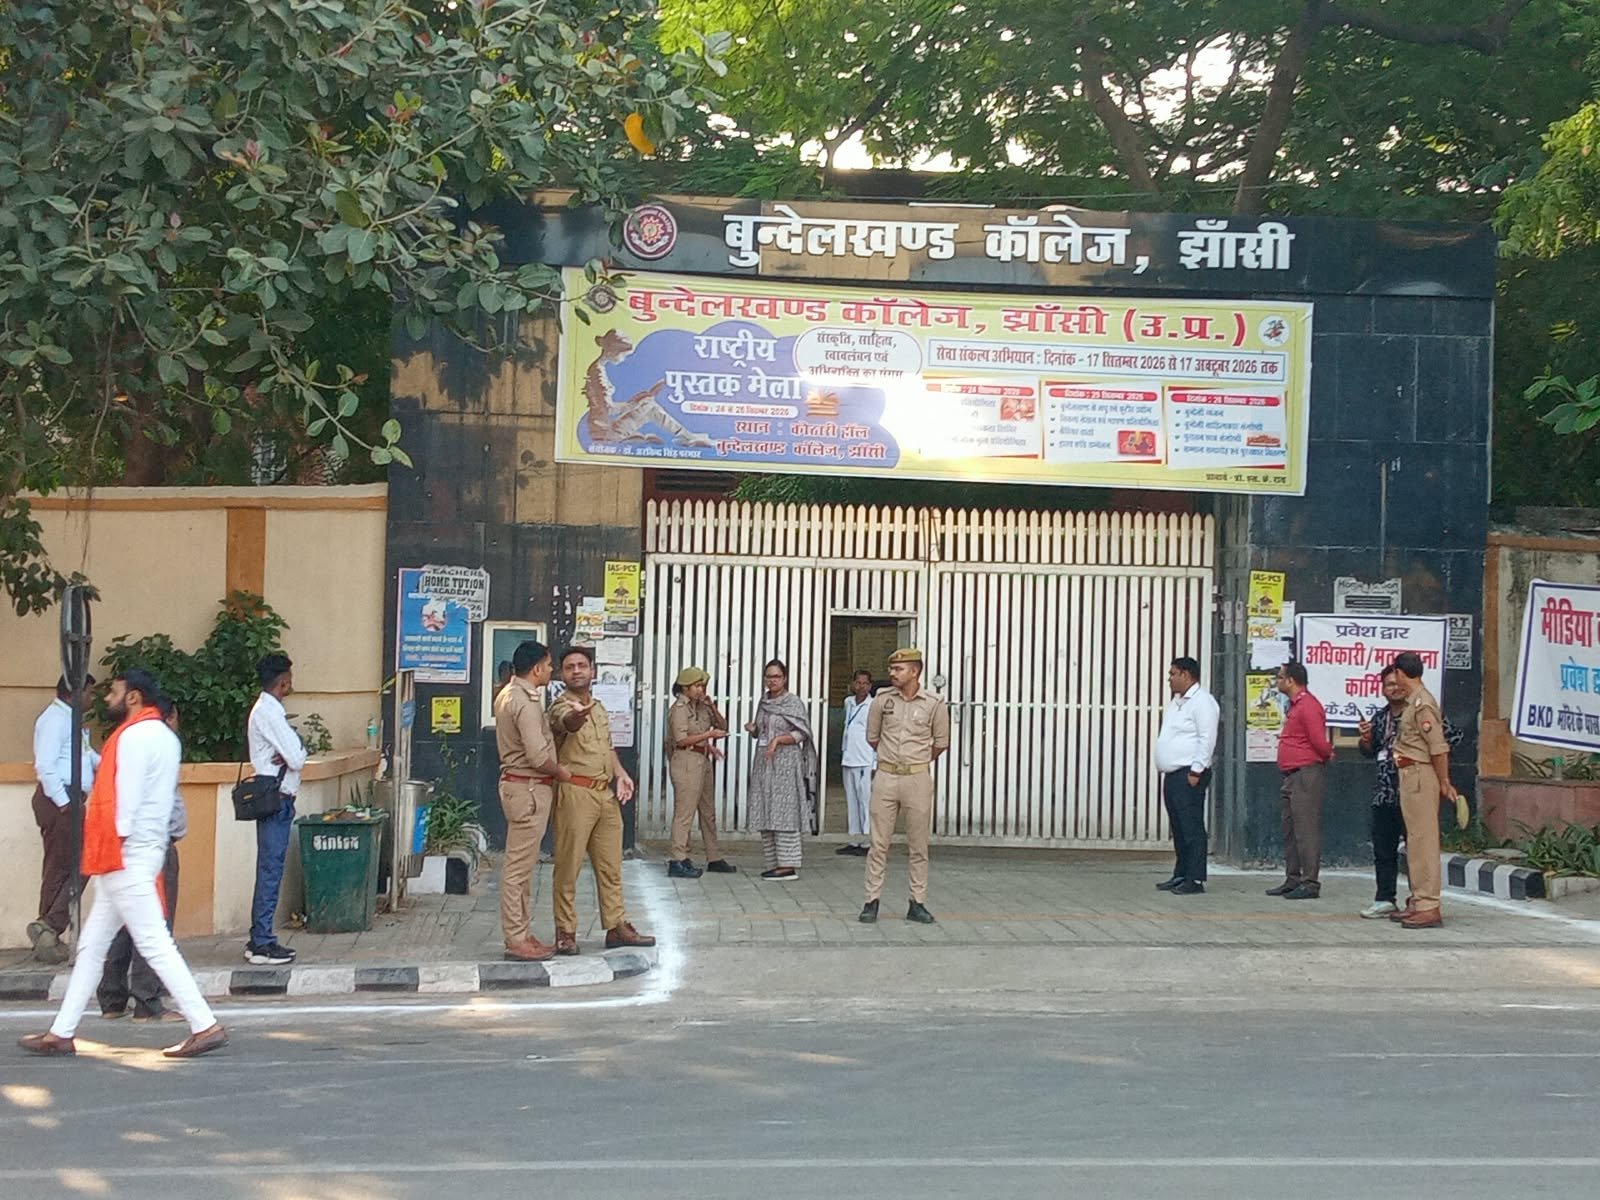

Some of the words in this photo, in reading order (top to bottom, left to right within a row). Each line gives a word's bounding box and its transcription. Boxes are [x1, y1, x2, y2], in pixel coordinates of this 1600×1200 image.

[723, 204, 958, 267] बुन्देलखण्ड
[984, 214, 1149, 273] कॉलेज,
[1178, 218, 1296, 271] झाँसी
[627, 286, 830, 322] बुन्देलखण्ड
[840, 297, 986, 335] कॉलेज,
[1002, 304, 1108, 335] झाँसी
[1123, 308, 1246, 347] (उ.प्र.)
[694, 328, 777, 368] राष्ट्रीय
[936, 344, 956, 361] सेवा
[959, 345, 989, 362] संकल्प
[991, 346, 1035, 364] अभियान
[1043, 349, 1076, 366] दिनांक
[1086, 353, 1099, 367] 17
[1102, 351, 1138, 369] सितम्बर
[1141, 355, 1165, 370] 2026
[1168, 355, 1176, 371] से
[1180, 358, 1191, 371] 17
[1232, 360, 1257, 374] 2026
[1261, 360, 1279, 374] तक
[665, 371, 742, 404] पुस्तक
[748, 367, 801, 400] मेला
[716, 437, 785, 456] बुन्देलखण्ड
[424, 576, 450, 588] HOME
[452, 577, 485, 590] TUTION
[1336, 622, 1377, 638] प्रवेश
[1380, 625, 1411, 639] द्वार
[1541, 596, 1594, 648] मीडिया
[1345, 673, 1384, 698] कार्मि
[1560, 655, 1589, 693] प्रवेश
[1527, 703, 1553, 728] BKD
